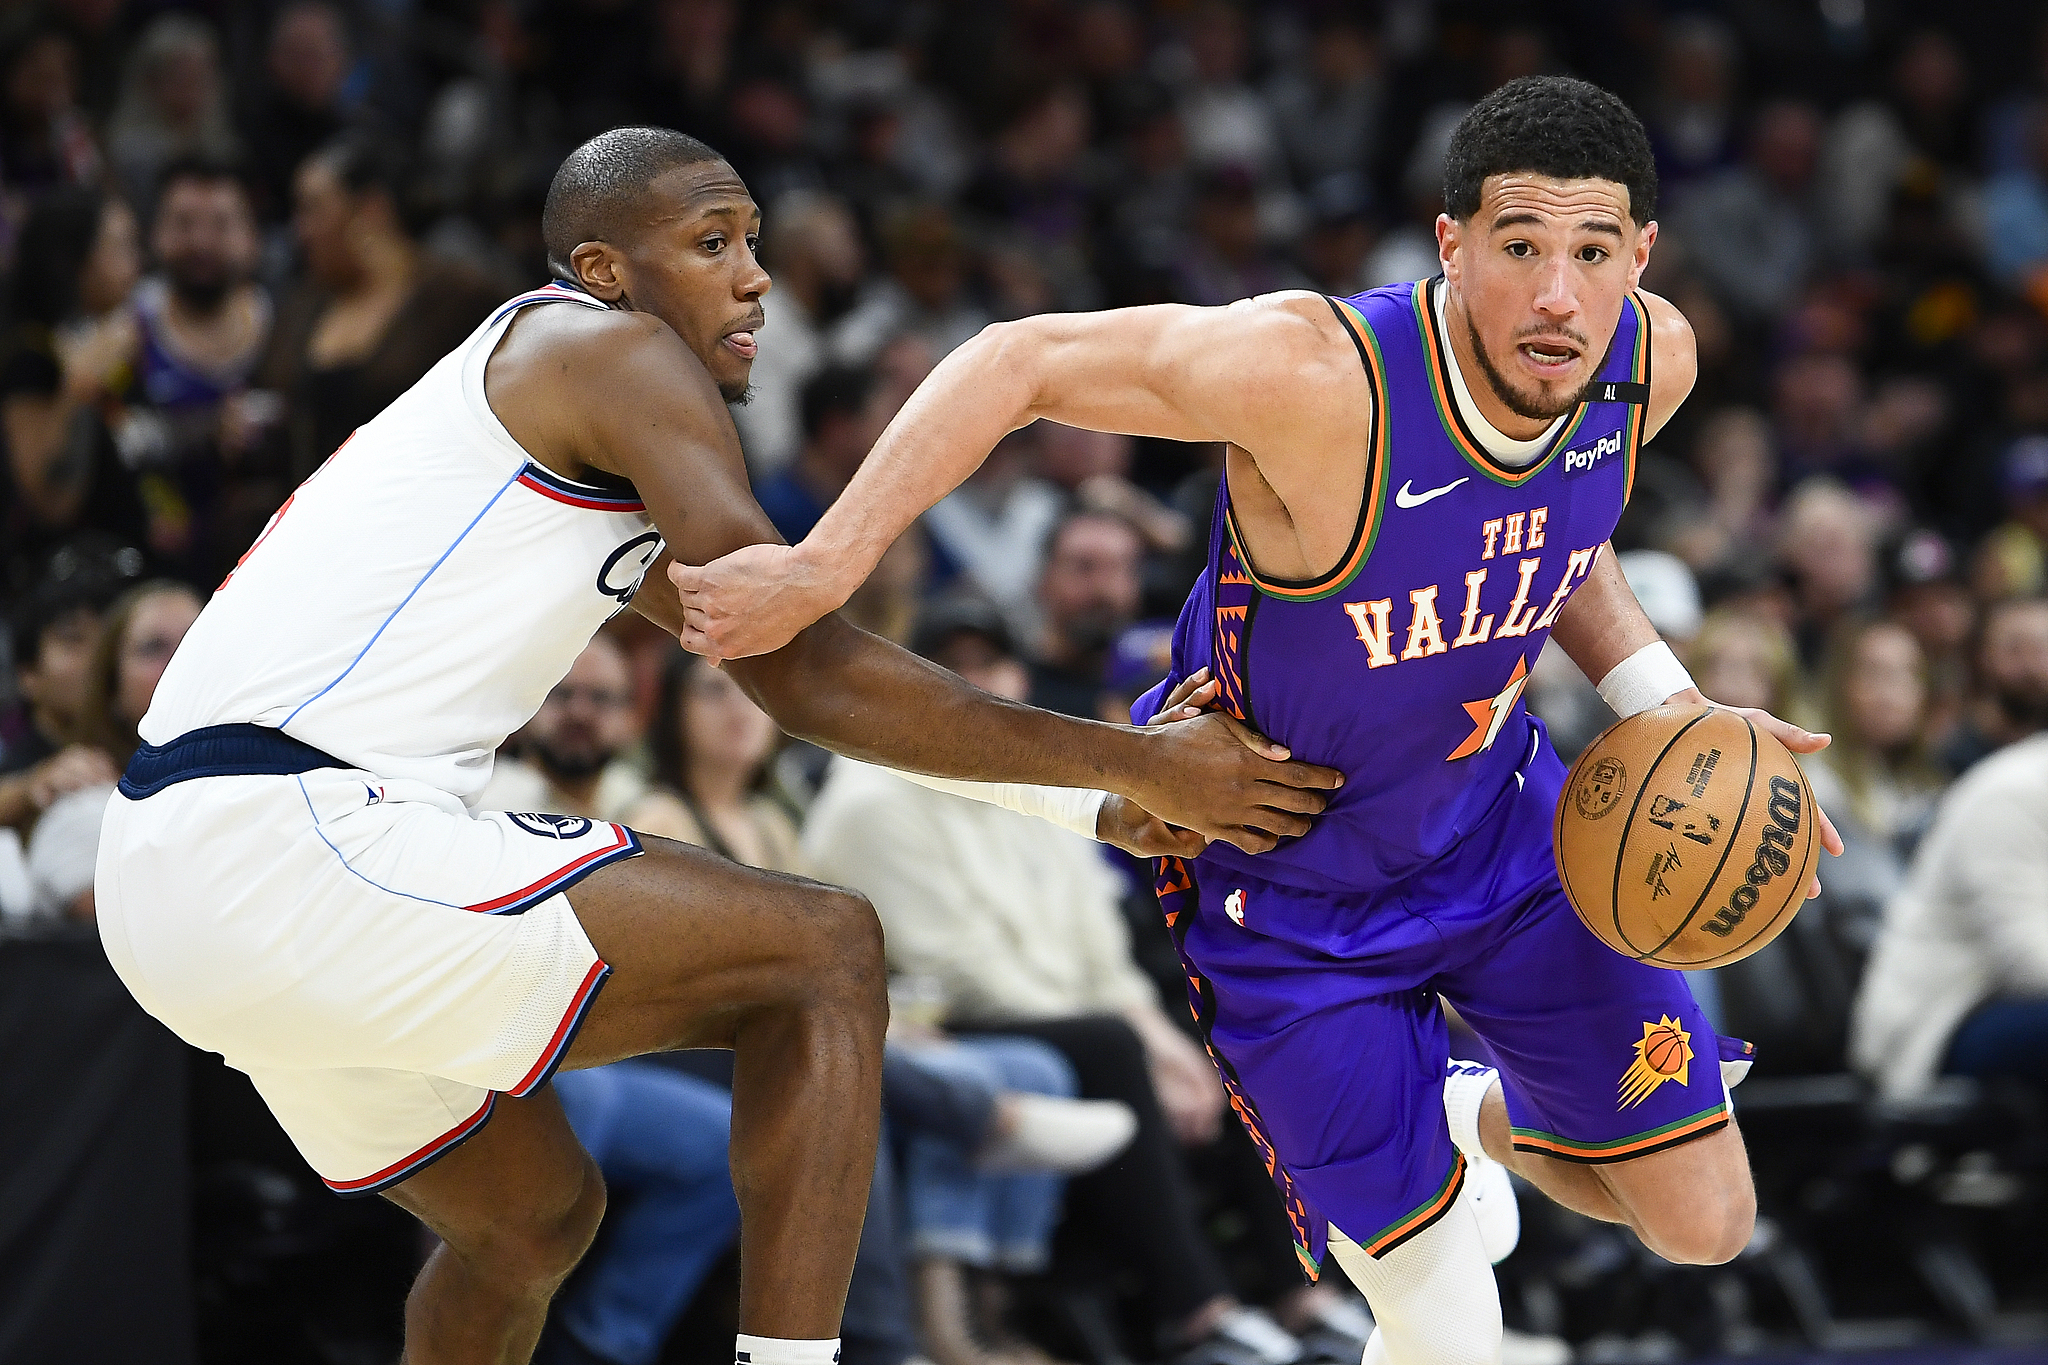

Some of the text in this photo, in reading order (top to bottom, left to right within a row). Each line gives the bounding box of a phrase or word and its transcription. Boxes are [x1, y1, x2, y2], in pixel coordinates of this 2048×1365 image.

[1603, 384, 1617, 401] AL
[1564, 430, 1622, 473] PayPal
[1481, 505, 1549, 561] THE
[1343, 542, 1606, 669] VALLE
[1700, 775, 1801, 937] Wilson
